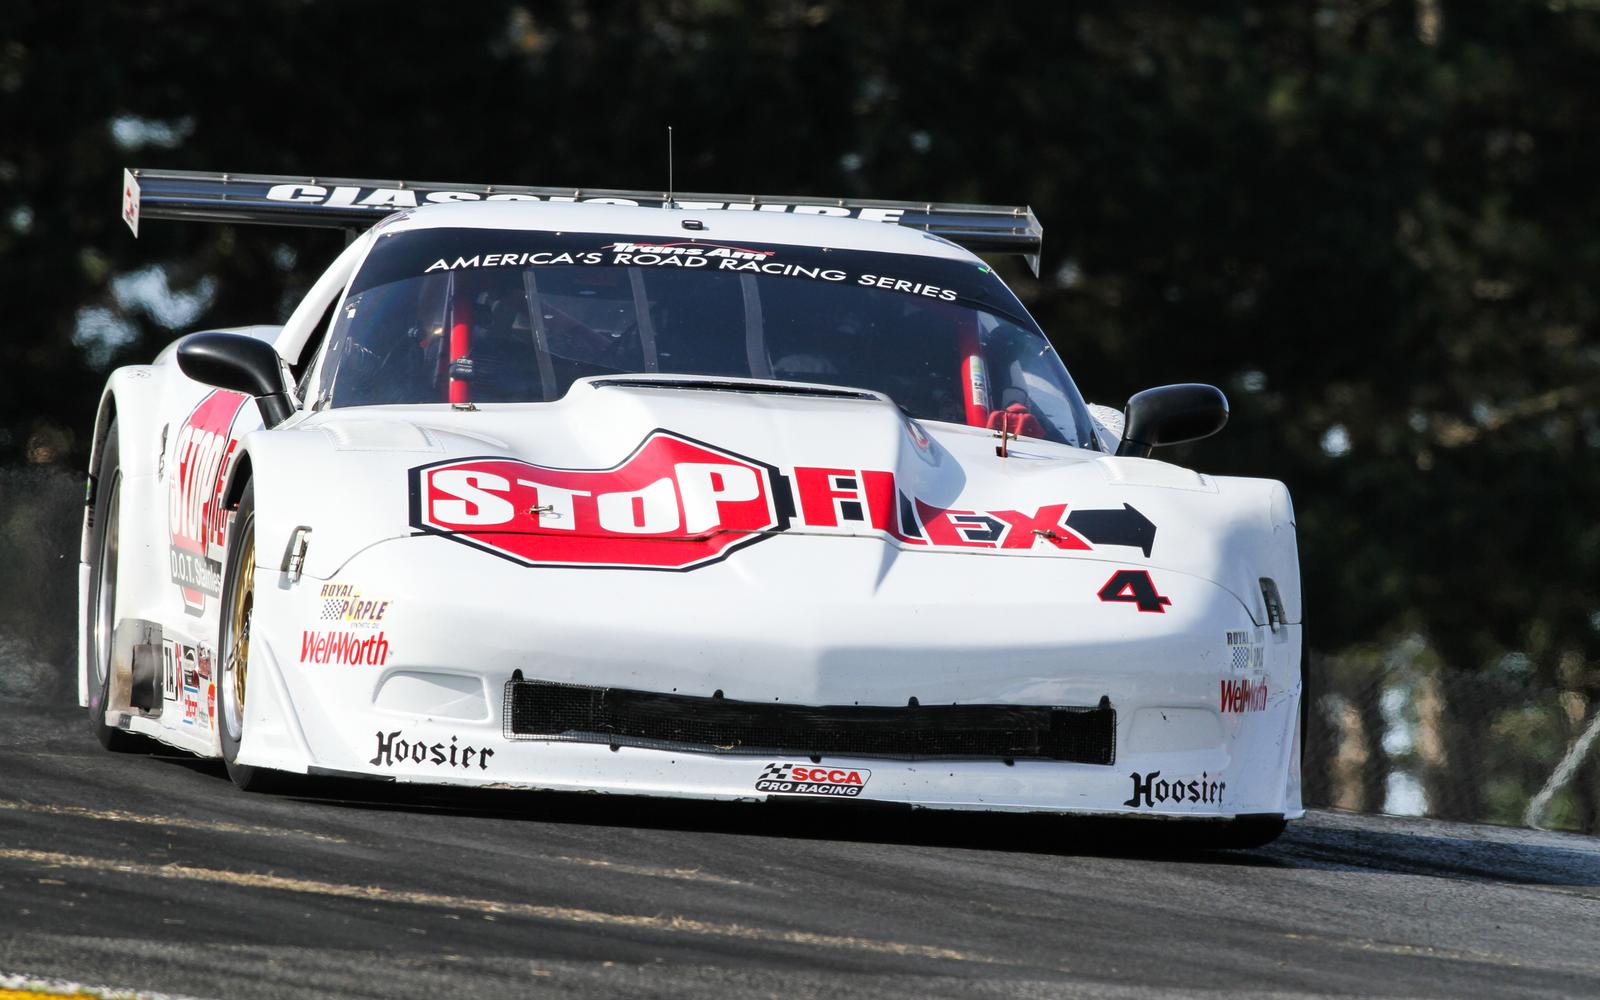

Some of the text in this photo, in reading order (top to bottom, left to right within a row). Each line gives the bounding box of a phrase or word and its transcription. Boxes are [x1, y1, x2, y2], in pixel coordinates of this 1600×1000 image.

[613, 242, 767, 262] Trans Am
[424, 252, 958, 301] AMERICA'S ROAD RACING SERIES
[432, 462, 1094, 551] STOP FLEX
[320, 584, 354, 597] ROYAL
[1096, 570, 1172, 613] 4
[369, 730, 495, 770] Hoosier
[758, 781, 859, 796] PRO RACING
[791, 767, 863, 785] SCCA
[1123, 770, 1226, 808] Hoosier
